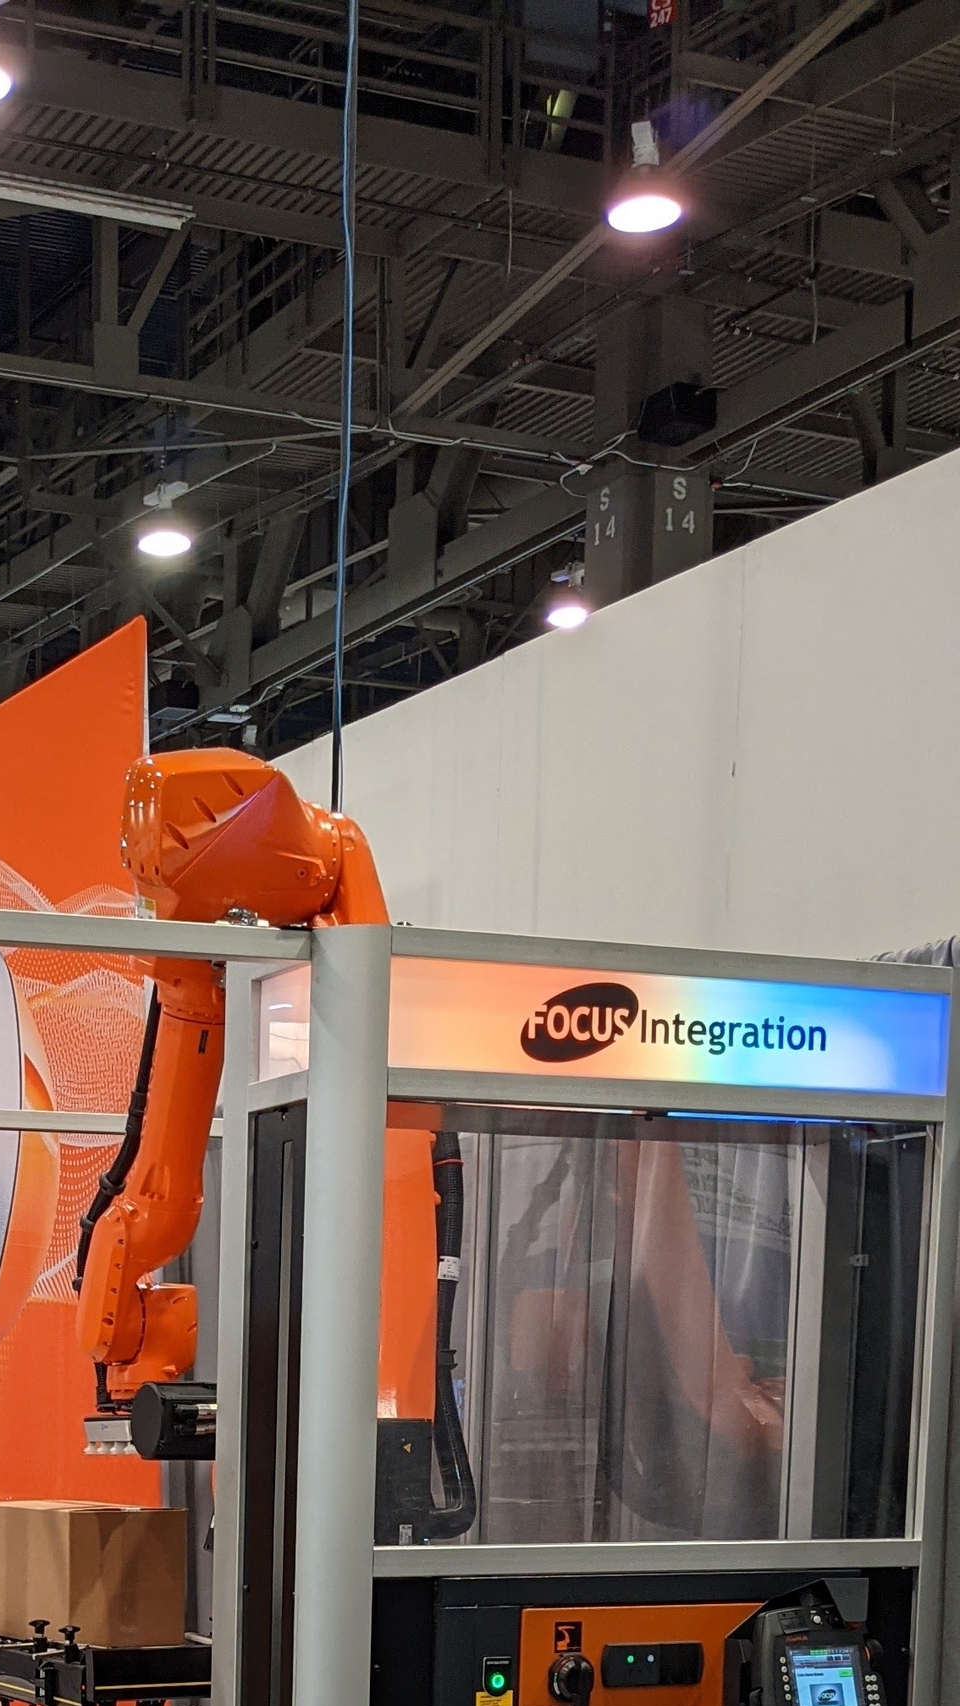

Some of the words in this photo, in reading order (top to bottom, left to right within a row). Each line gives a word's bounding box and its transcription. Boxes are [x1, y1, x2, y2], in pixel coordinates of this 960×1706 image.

[649, 7, 672, 29] 247
[599, 487, 611, 511] S
[672, 476, 688, 501] S
[594, 515, 616, 546] 14
[665, 507, 696, 534] 14
[527, 1004, 630, 1043] FOCUS
[640, 1008, 827, 1056] Integration
